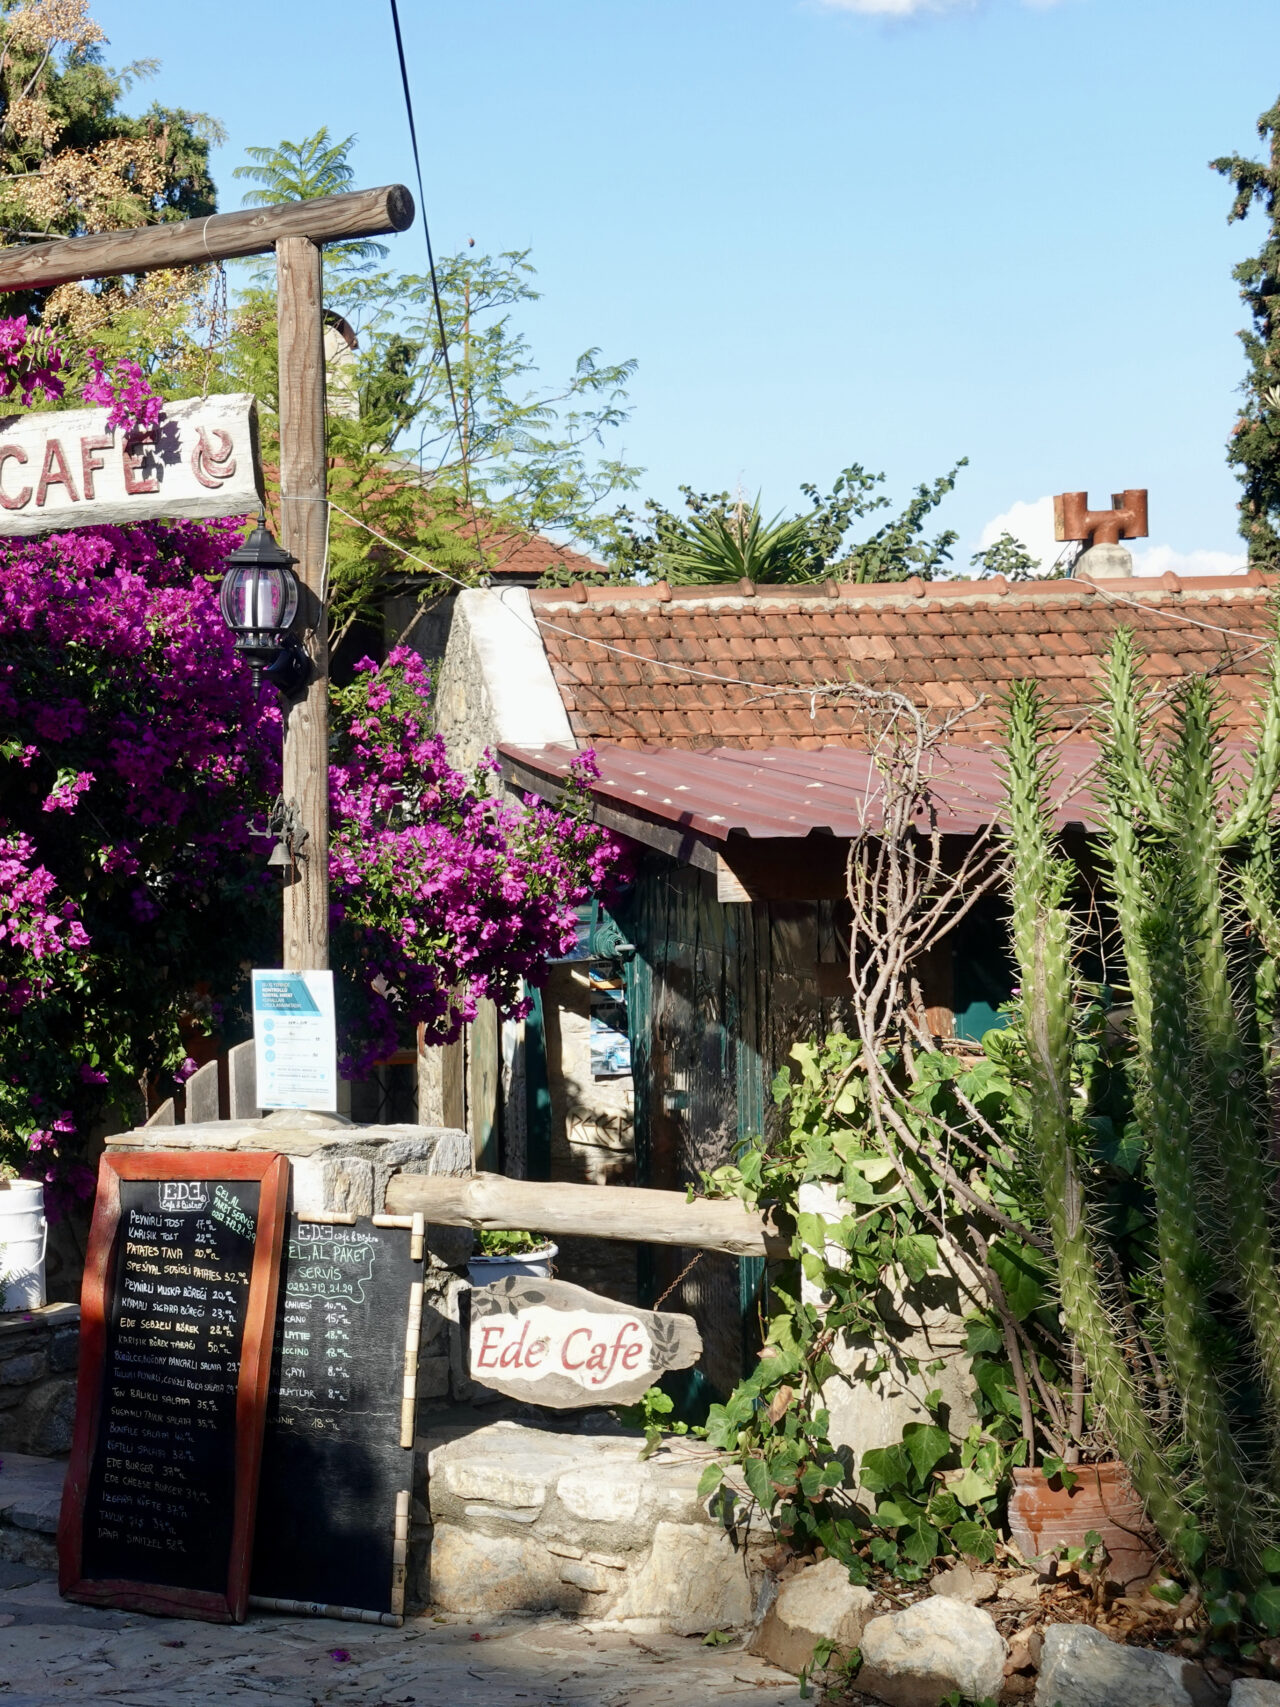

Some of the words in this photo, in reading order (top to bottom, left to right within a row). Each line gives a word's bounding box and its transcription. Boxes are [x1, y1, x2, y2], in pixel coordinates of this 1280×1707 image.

[164, 1219, 185, 1228] TOST
[160, 1232, 179, 1241] TOST
[126, 1242, 159, 1257] PATATES
[161, 1246, 184, 1259] TAVA
[333, 1245, 369, 1264] PAKET
[193, 1266, 222, 1281] PATATES
[298, 1266, 342, 1280] SERVİS
[157, 1284, 182, 1296] MUSKA
[120, 1317, 136, 1328] EDE
[175, 1321, 200, 1335] BÖREK
[284, 1330, 311, 1340] LATTE
[476, 1319, 548, 1369] Ede
[561, 1321, 643, 1385] Cafe
[112, 1387, 125, 1397] TON
[161, 1395, 191, 1406] SALATA
[166, 1416, 192, 1426] SALATA
[106, 1457, 122, 1469] EDE
[125, 1459, 154, 1475] BURGER
[104, 1473, 119, 1484] EDE
[123, 1476, 152, 1489] CHEESE
[154, 1481, 182, 1495] BURGER
